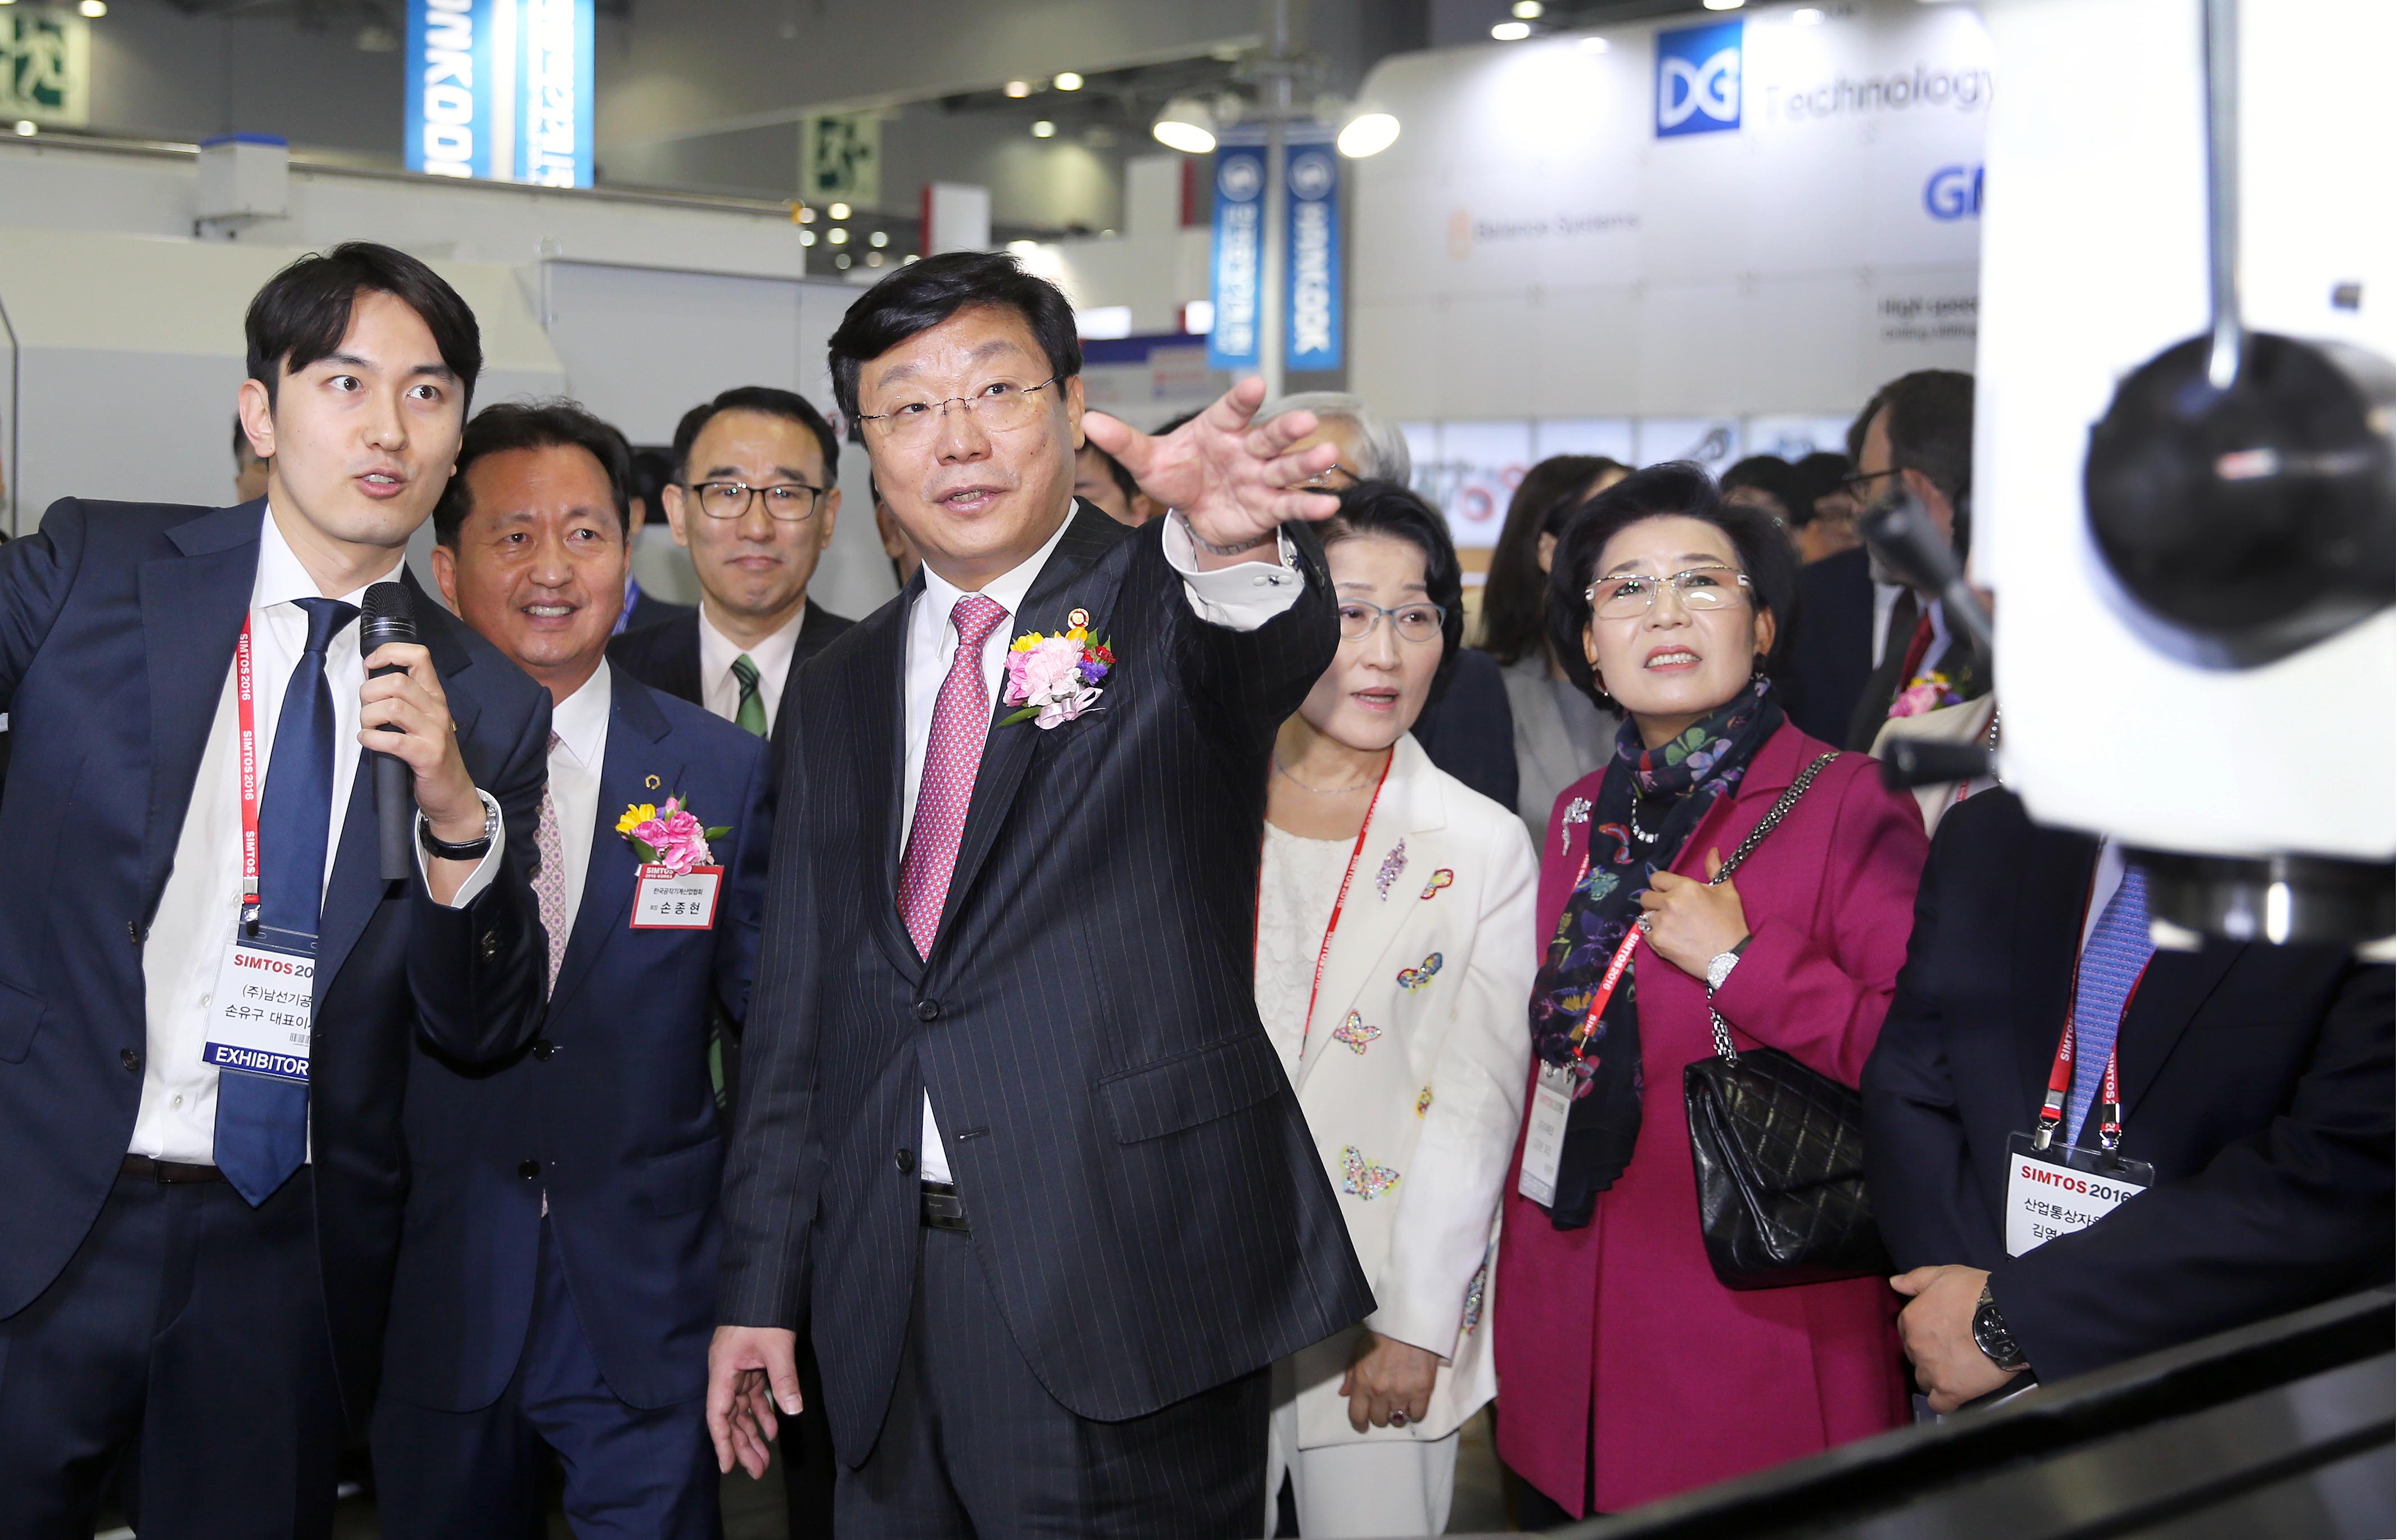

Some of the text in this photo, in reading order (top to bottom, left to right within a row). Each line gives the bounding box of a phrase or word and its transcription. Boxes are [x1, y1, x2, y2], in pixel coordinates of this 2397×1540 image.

[1660, 47, 1741, 129] DG
[1294, 201, 1330, 355] HANKOOK
[246, 830, 256, 876] SIMTOS
[225, 1004, 264, 1021] 손유구
[1583, 1013, 1597, 1035] SIM
[216, 1047, 309, 1076] EXHIBITOR
[2021, 1165, 2087, 1193] SIMTOS
[2033, 1223, 2065, 1240] 김영
